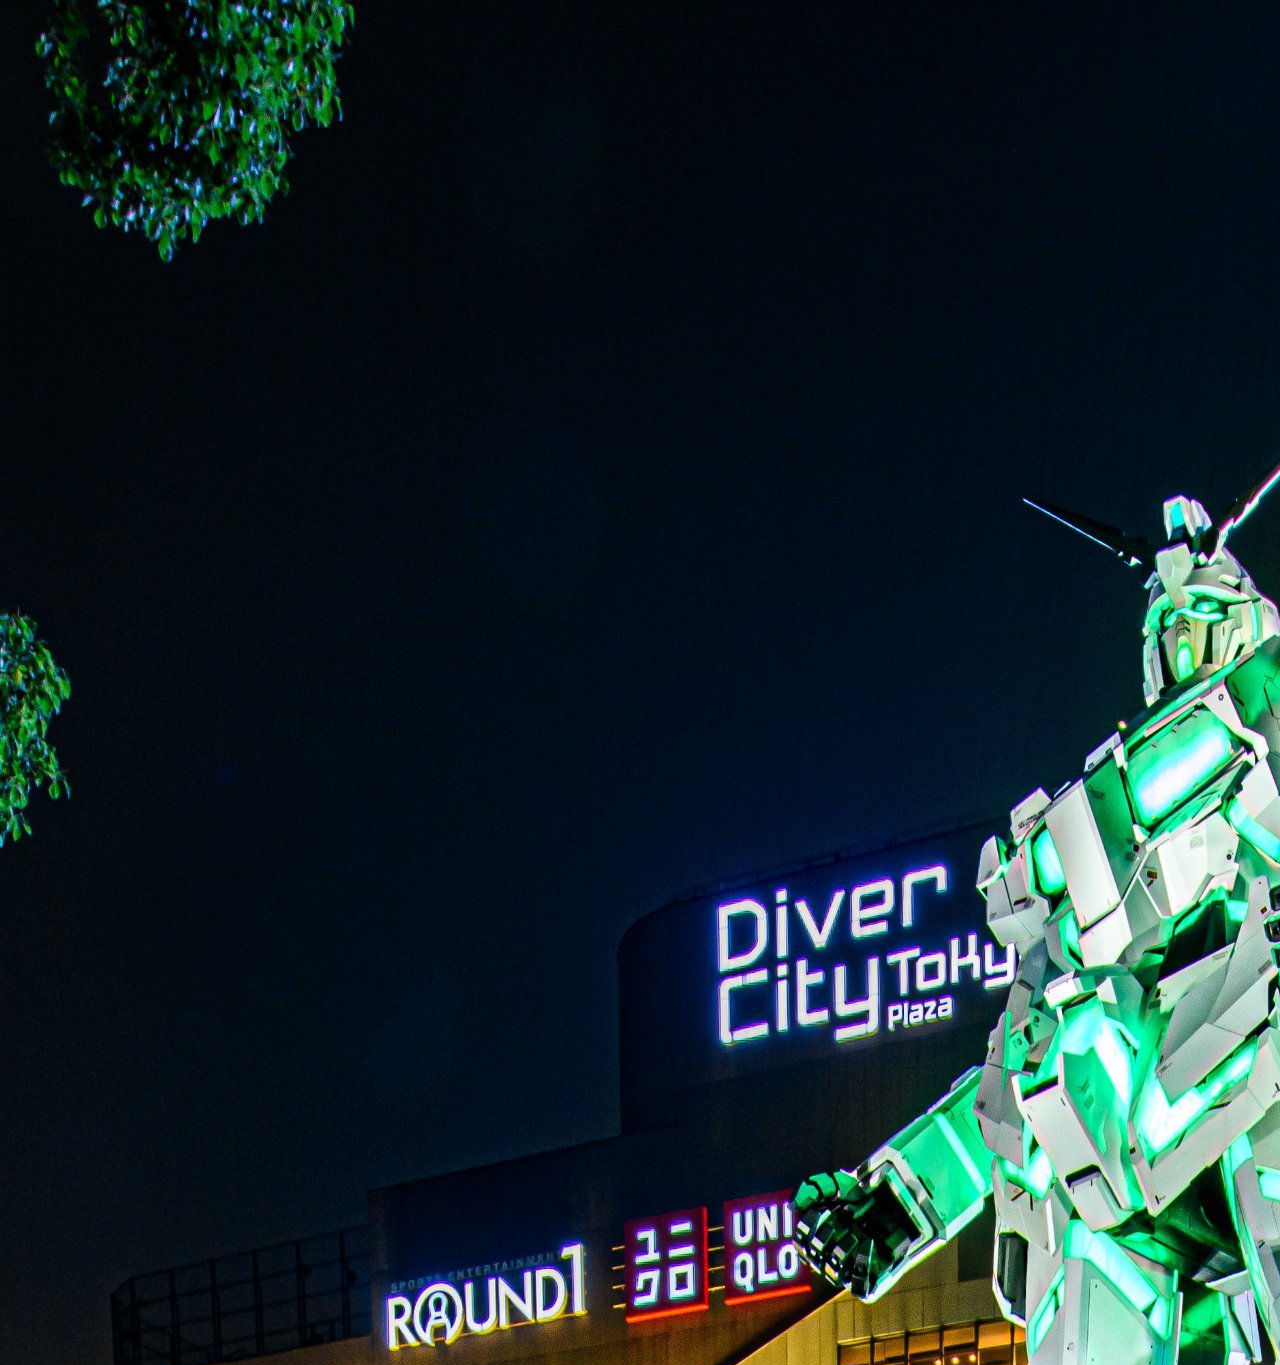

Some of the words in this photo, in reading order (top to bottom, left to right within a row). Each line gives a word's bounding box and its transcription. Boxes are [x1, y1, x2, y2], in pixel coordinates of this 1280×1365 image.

[717, 864, 948, 973] Diver
[719, 957, 880, 1044] City
[885, 933, 1022, 997] Toky
[887, 996, 953, 1030] Plaza
[732, 1202, 794, 1245] UNI
[387, 1242, 586, 1350] ROUND1
[733, 1244, 799, 1292] QLO
